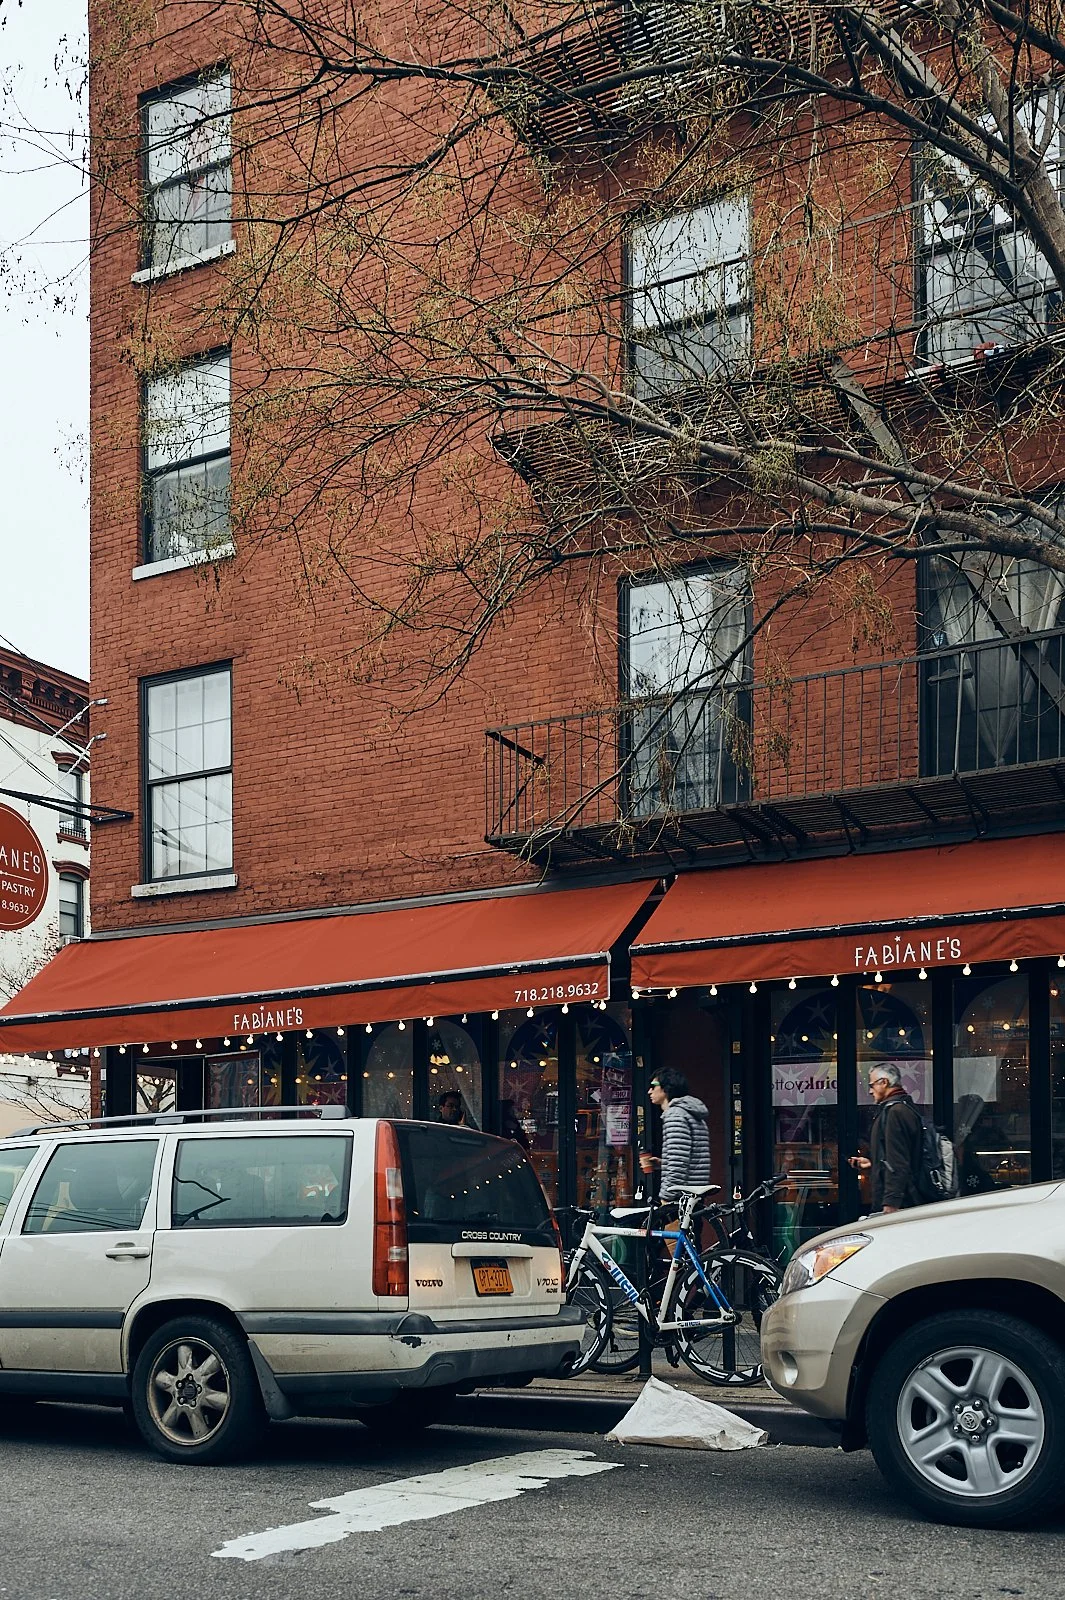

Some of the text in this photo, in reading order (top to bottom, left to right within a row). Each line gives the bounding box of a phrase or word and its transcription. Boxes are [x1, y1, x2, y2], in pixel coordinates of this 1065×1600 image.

[1, 880, 35, 898] PASTRY
[1, 899, 29, 915] 8.9632
[855, 936, 961, 967] FABIANE'S
[514, 982, 599, 1003] 718.218.9632
[234, 1006, 303, 1031] FABIANE'S
[461, 1230, 522, 1241] CROSS COUNTRY
[415, 1279, 444, 1287] VOLVO
